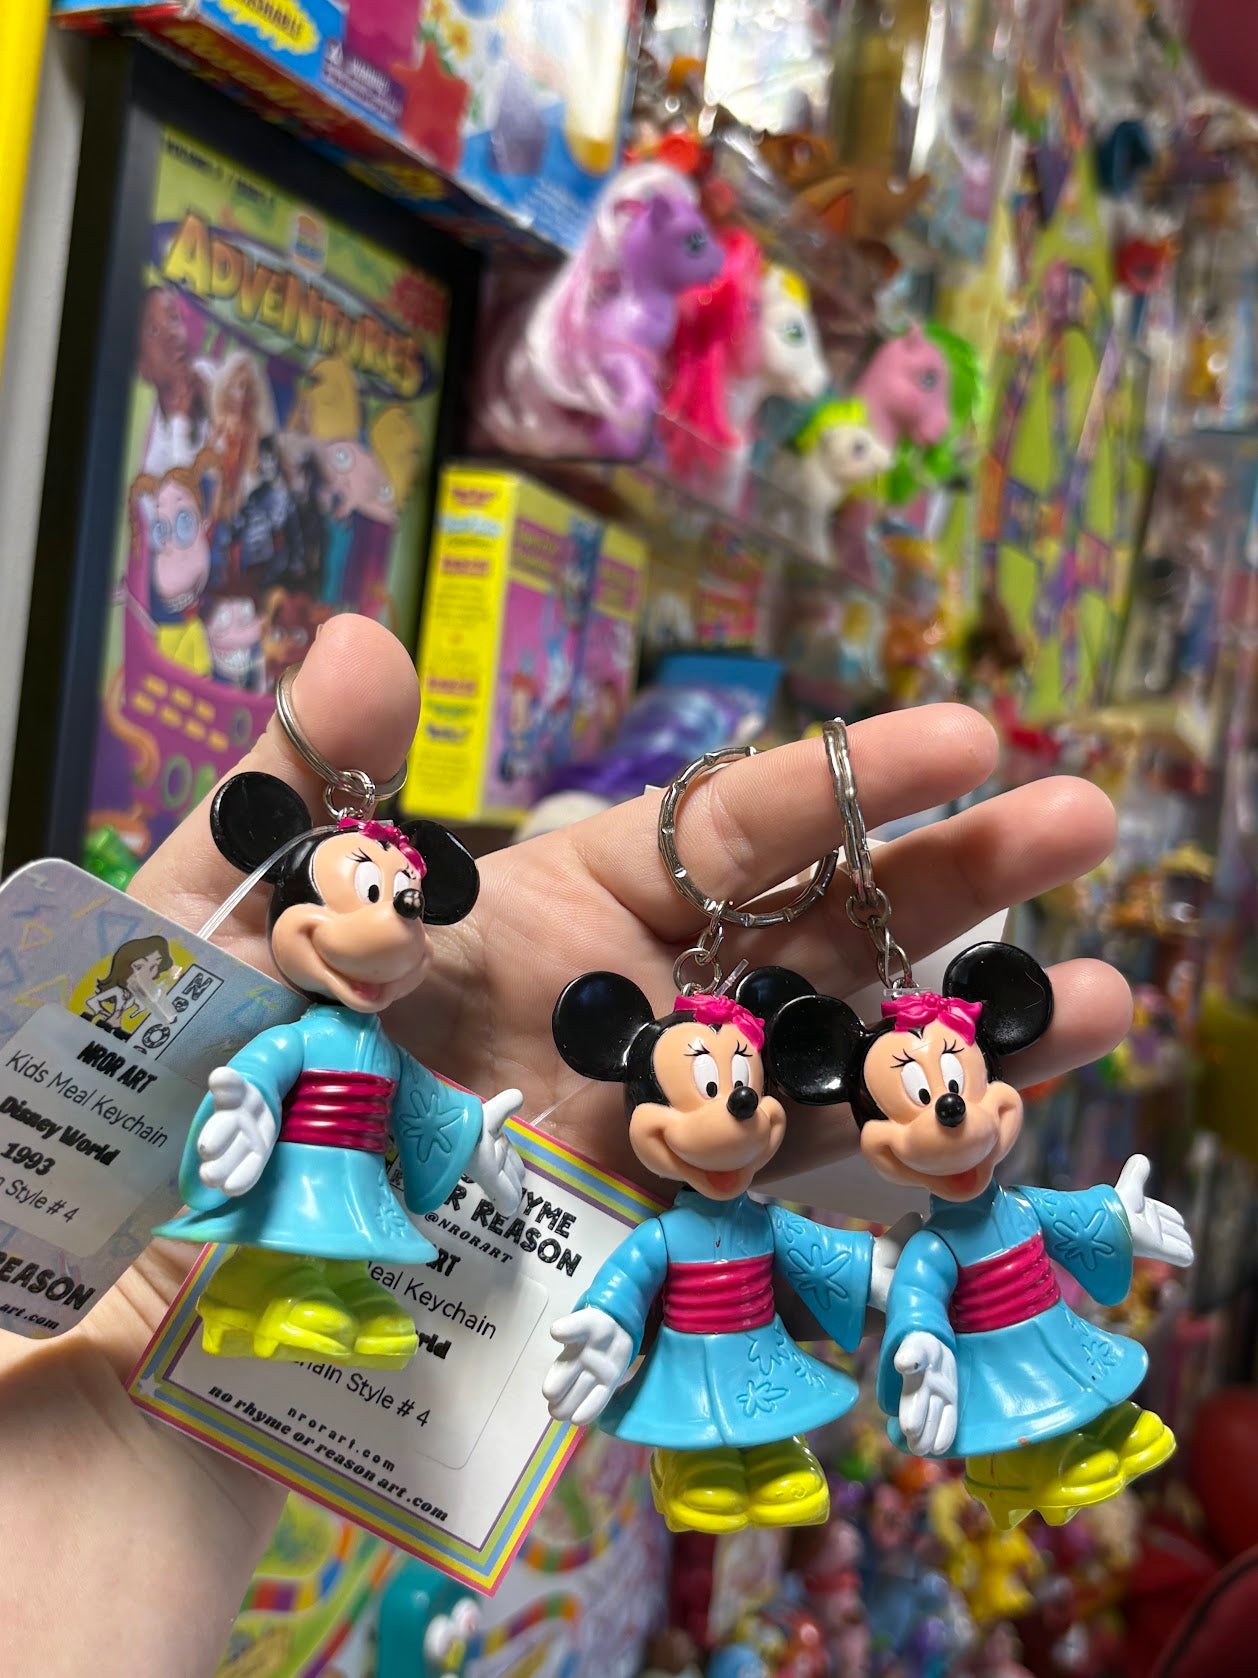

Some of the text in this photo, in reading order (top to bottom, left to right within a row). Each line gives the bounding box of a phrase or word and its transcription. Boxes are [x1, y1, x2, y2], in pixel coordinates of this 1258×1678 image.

[163, 206, 424, 398] ADVENTURES
[77, 1041, 158, 1093] NROR ART
[5, 1050, 168, 1148] Kids Meal Keychain
[0, 1095, 121, 1166] Disney World
[0, 1142, 56, 1176] 1993
[5, 1179, 48, 1209] Style
[521, 1187, 577, 1239] YME
[424, 1212, 513, 1264] @NRORART
[471, 1198, 582, 1278] REASON
[368, 1261, 404, 1290] eal
[403, 1277, 497, 1340] Keychain
[346, 1373, 392, 1410] Style
[208, 1385, 233, 1403] no
[234, 1399, 292, 1435] rhyme
[292, 1431, 316, 1448] or
[314, 1443, 376, 1482] reason
[287, 1406, 396, 1472] nrorart.com
